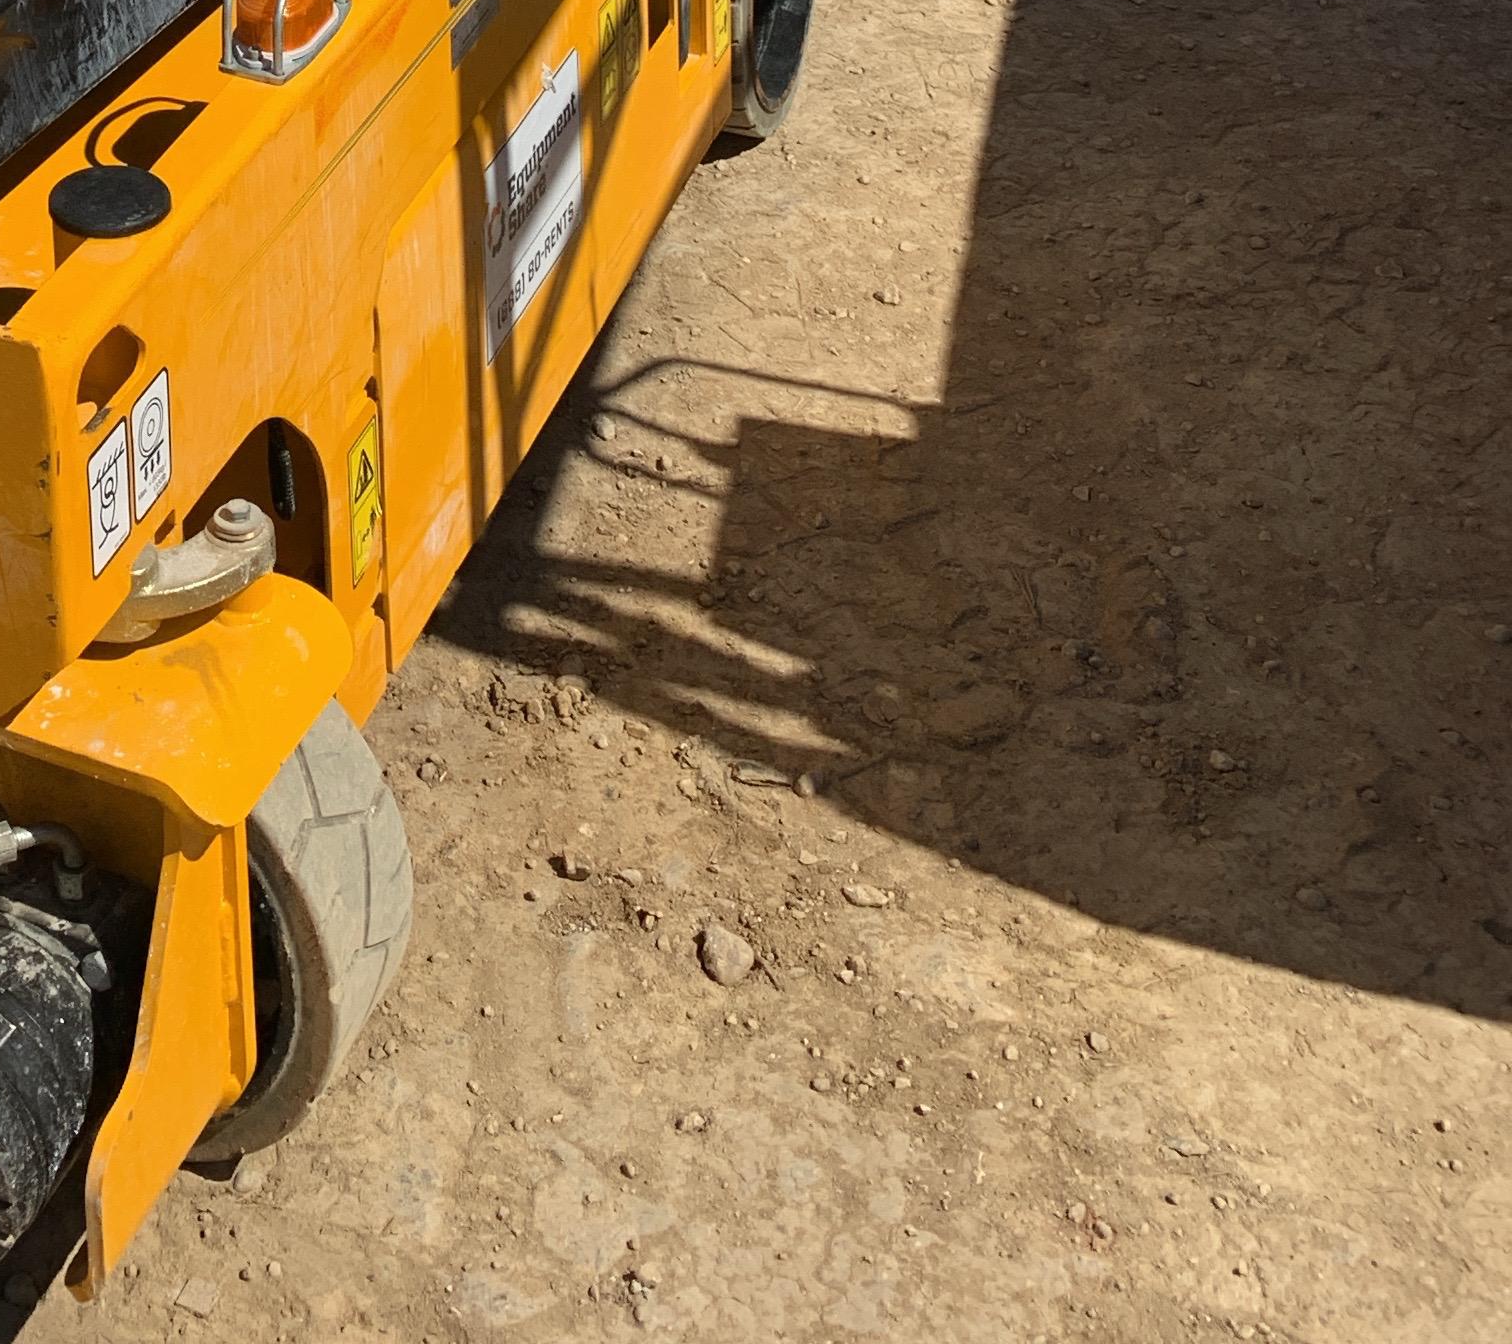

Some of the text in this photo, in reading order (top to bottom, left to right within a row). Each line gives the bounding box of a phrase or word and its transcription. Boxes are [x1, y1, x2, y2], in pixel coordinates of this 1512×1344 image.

[506, 92, 577, 208] Equipment
[497, 200, 576, 331] (888) 80-RENTS
[507, 175, 547, 242] Share
